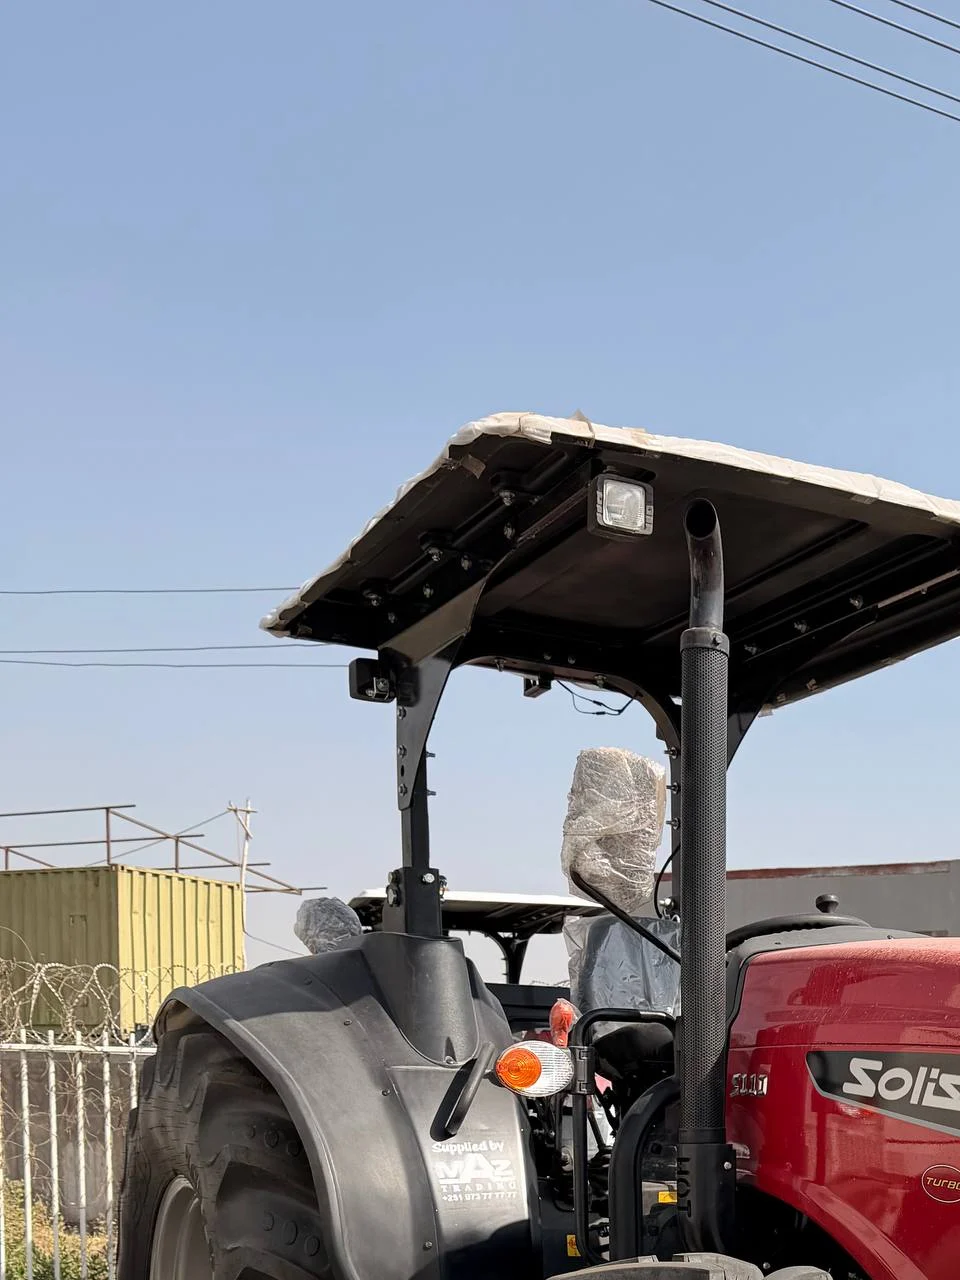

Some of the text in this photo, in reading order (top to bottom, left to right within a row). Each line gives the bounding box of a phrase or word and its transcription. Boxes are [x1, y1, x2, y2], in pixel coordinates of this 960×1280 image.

[431, 1139, 504, 1156] Supplied by
[434, 1152, 514, 1184] MAZ
[440, 1182, 517, 1193] TRADING
